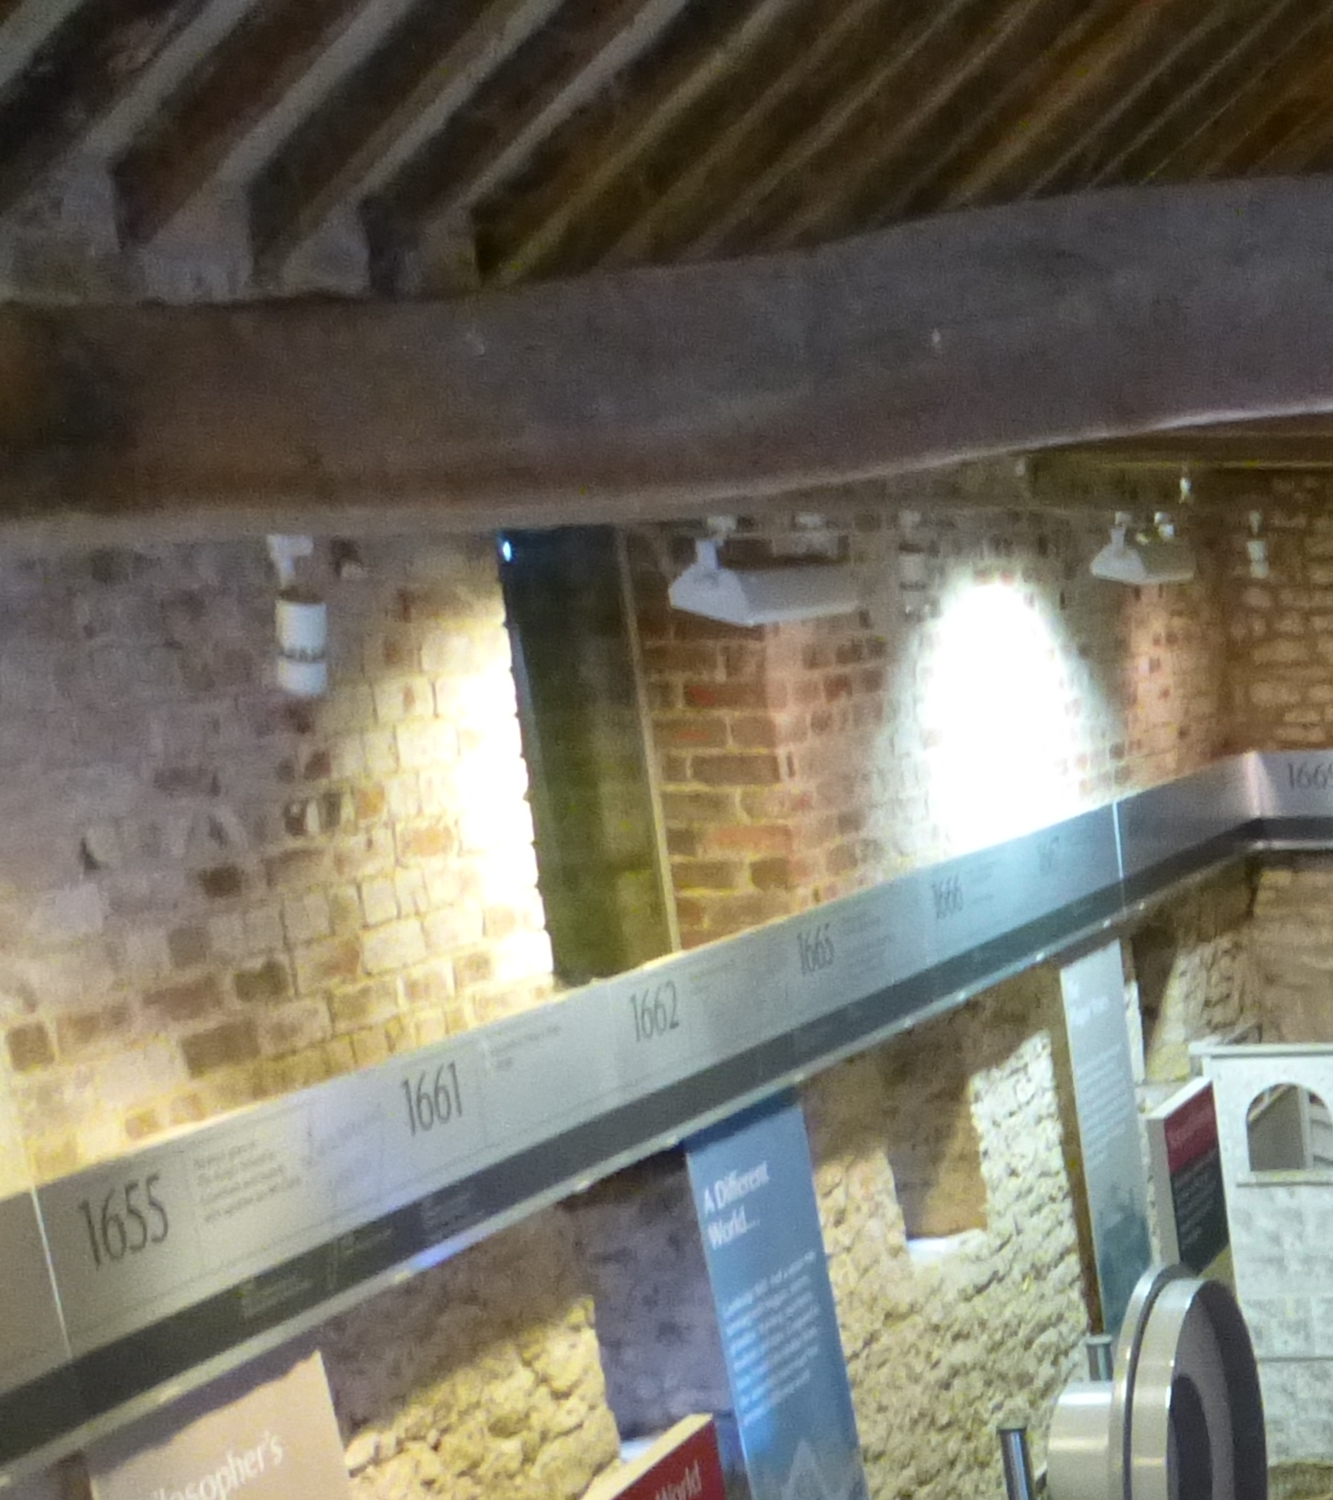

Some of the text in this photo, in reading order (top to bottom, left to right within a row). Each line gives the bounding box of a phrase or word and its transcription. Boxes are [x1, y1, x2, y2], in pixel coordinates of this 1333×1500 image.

[630, 980, 680, 1044] 1662
[401, 1060, 465, 1137] 1661
[78, 1172, 170, 1271] 1655
